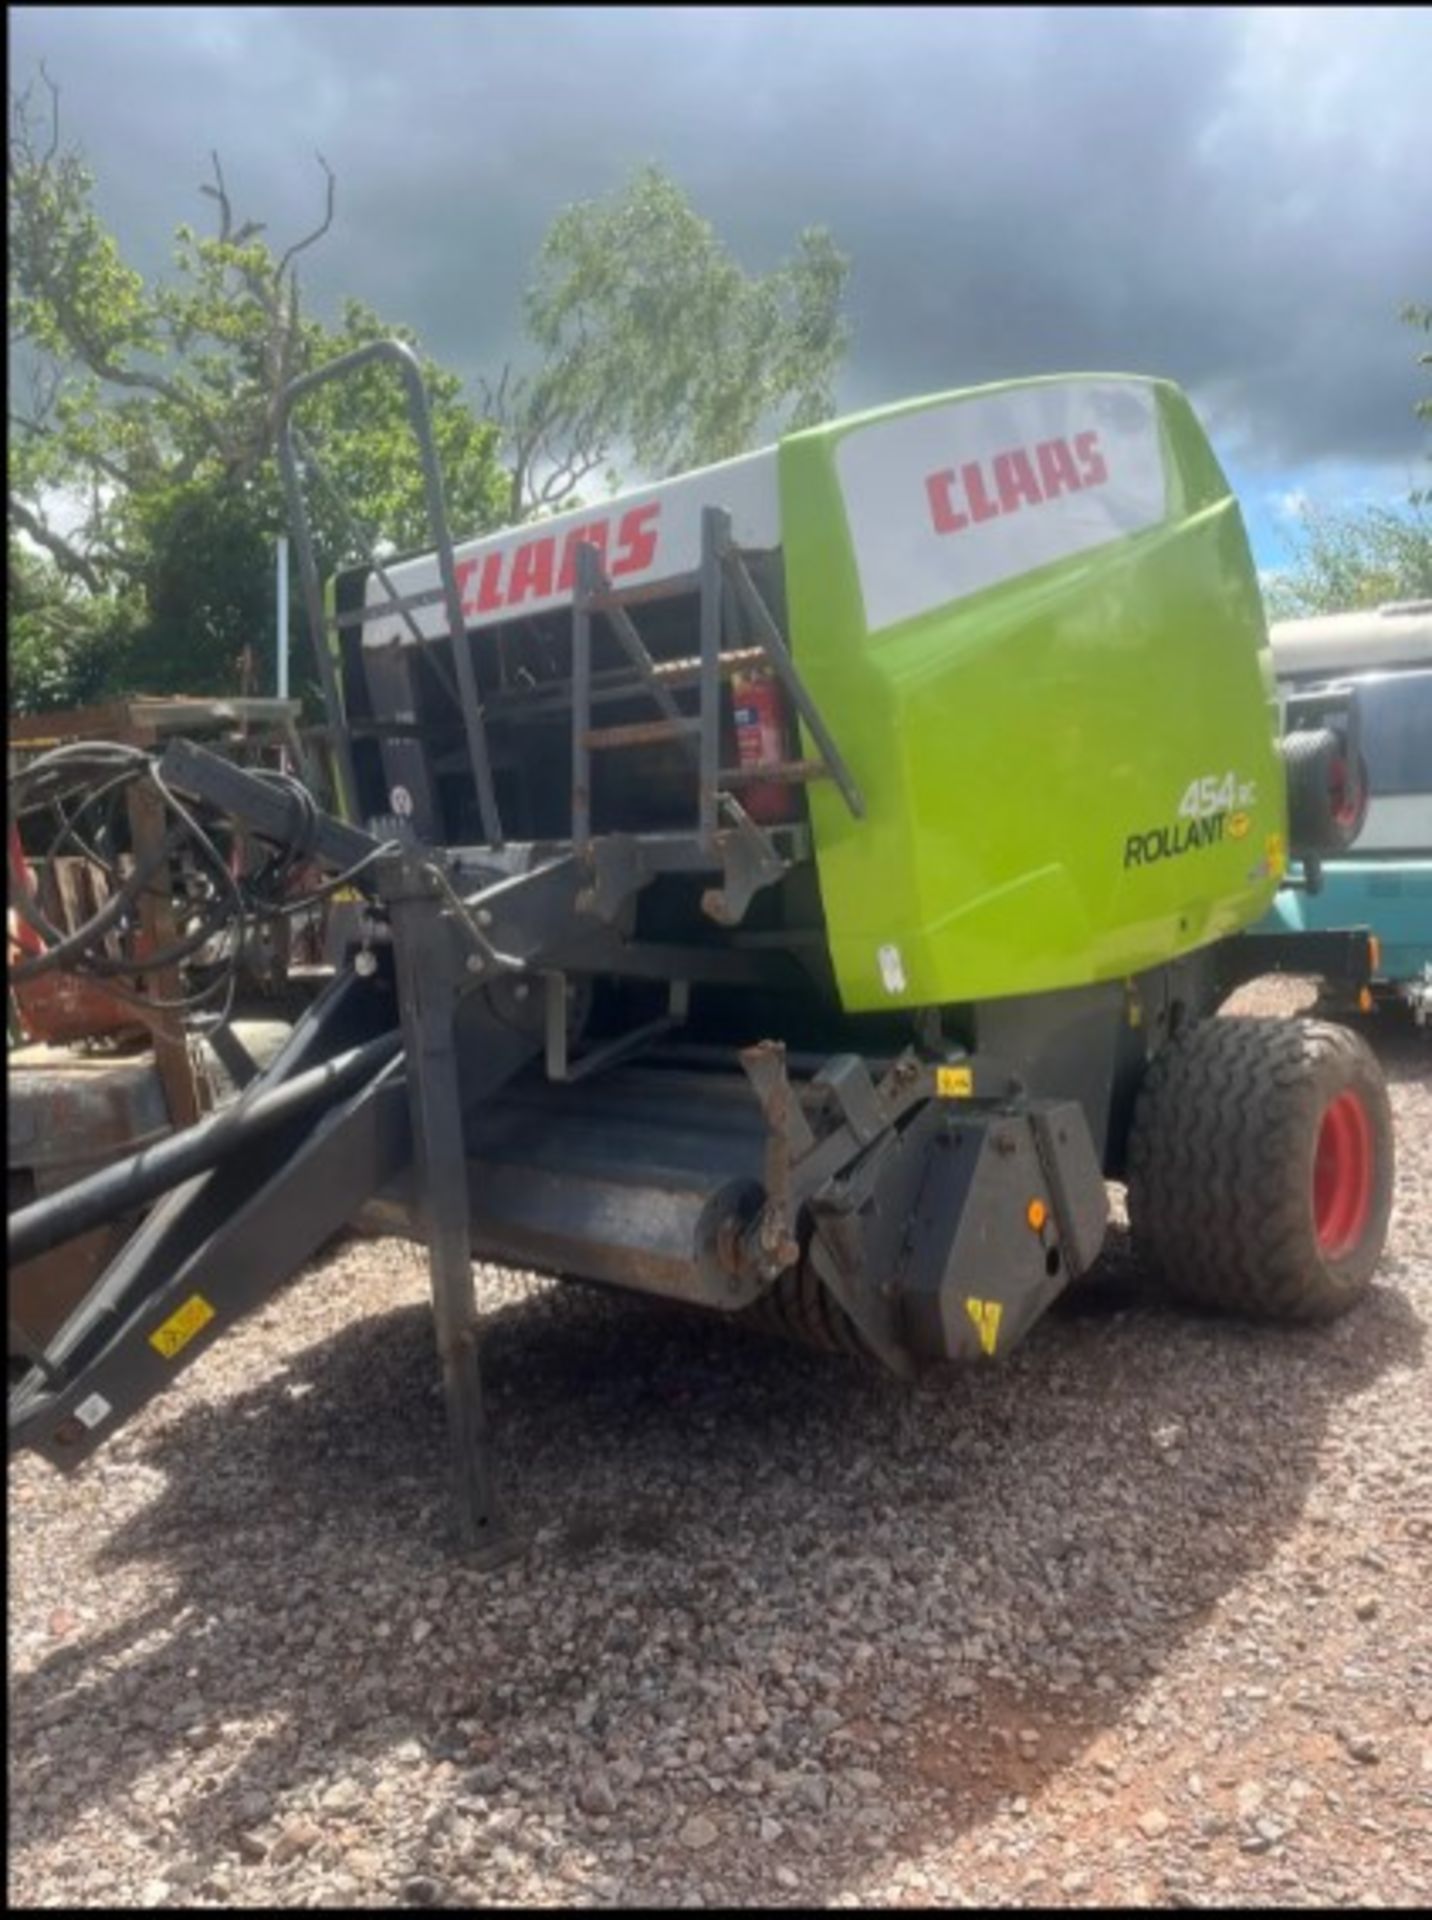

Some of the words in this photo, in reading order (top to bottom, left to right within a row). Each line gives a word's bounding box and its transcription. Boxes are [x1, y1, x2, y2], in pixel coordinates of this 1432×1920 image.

[924, 430, 1108, 535] CLAAS
[1179, 772, 1235, 817] 454
[1124, 813, 1225, 869] ROLLANT
